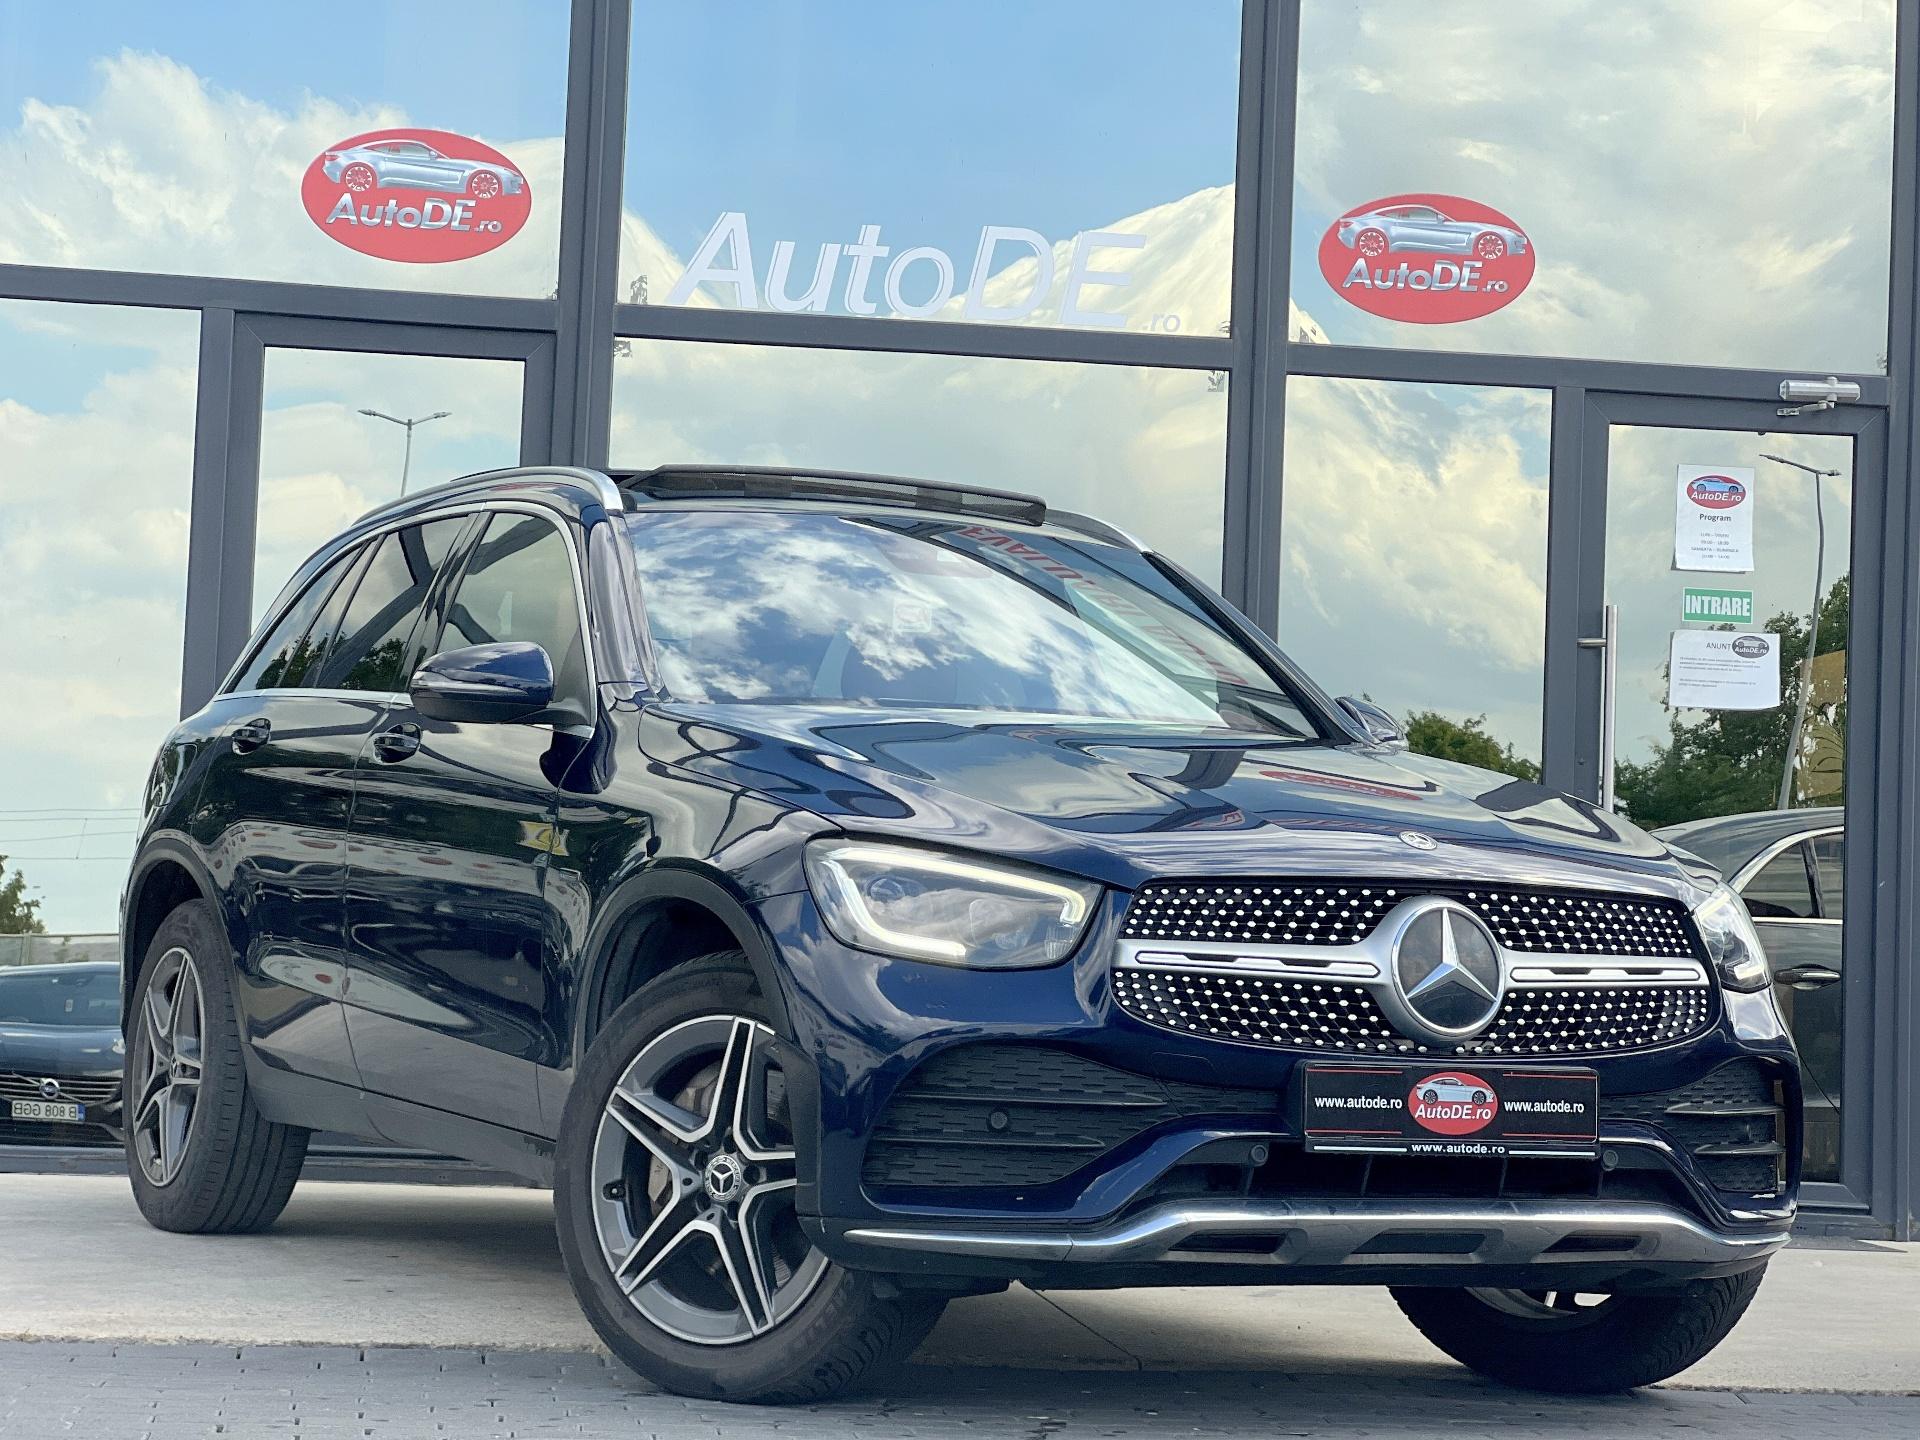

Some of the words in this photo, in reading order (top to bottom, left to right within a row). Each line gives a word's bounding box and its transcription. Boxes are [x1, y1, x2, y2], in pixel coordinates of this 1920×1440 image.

[1691, 491, 1742, 502] AutoDE.ro
[1700, 513, 1732, 522] Program
[1685, 595, 1750, 617] INTRARE
[1314, 1095, 1403, 1110] www.autode.ro
[1504, 1098, 1585, 1114] www.autode.ro
[1414, 1103, 1491, 1121] AutoDE.ro
[1411, 1142, 1505, 1155] www.autode.ro
